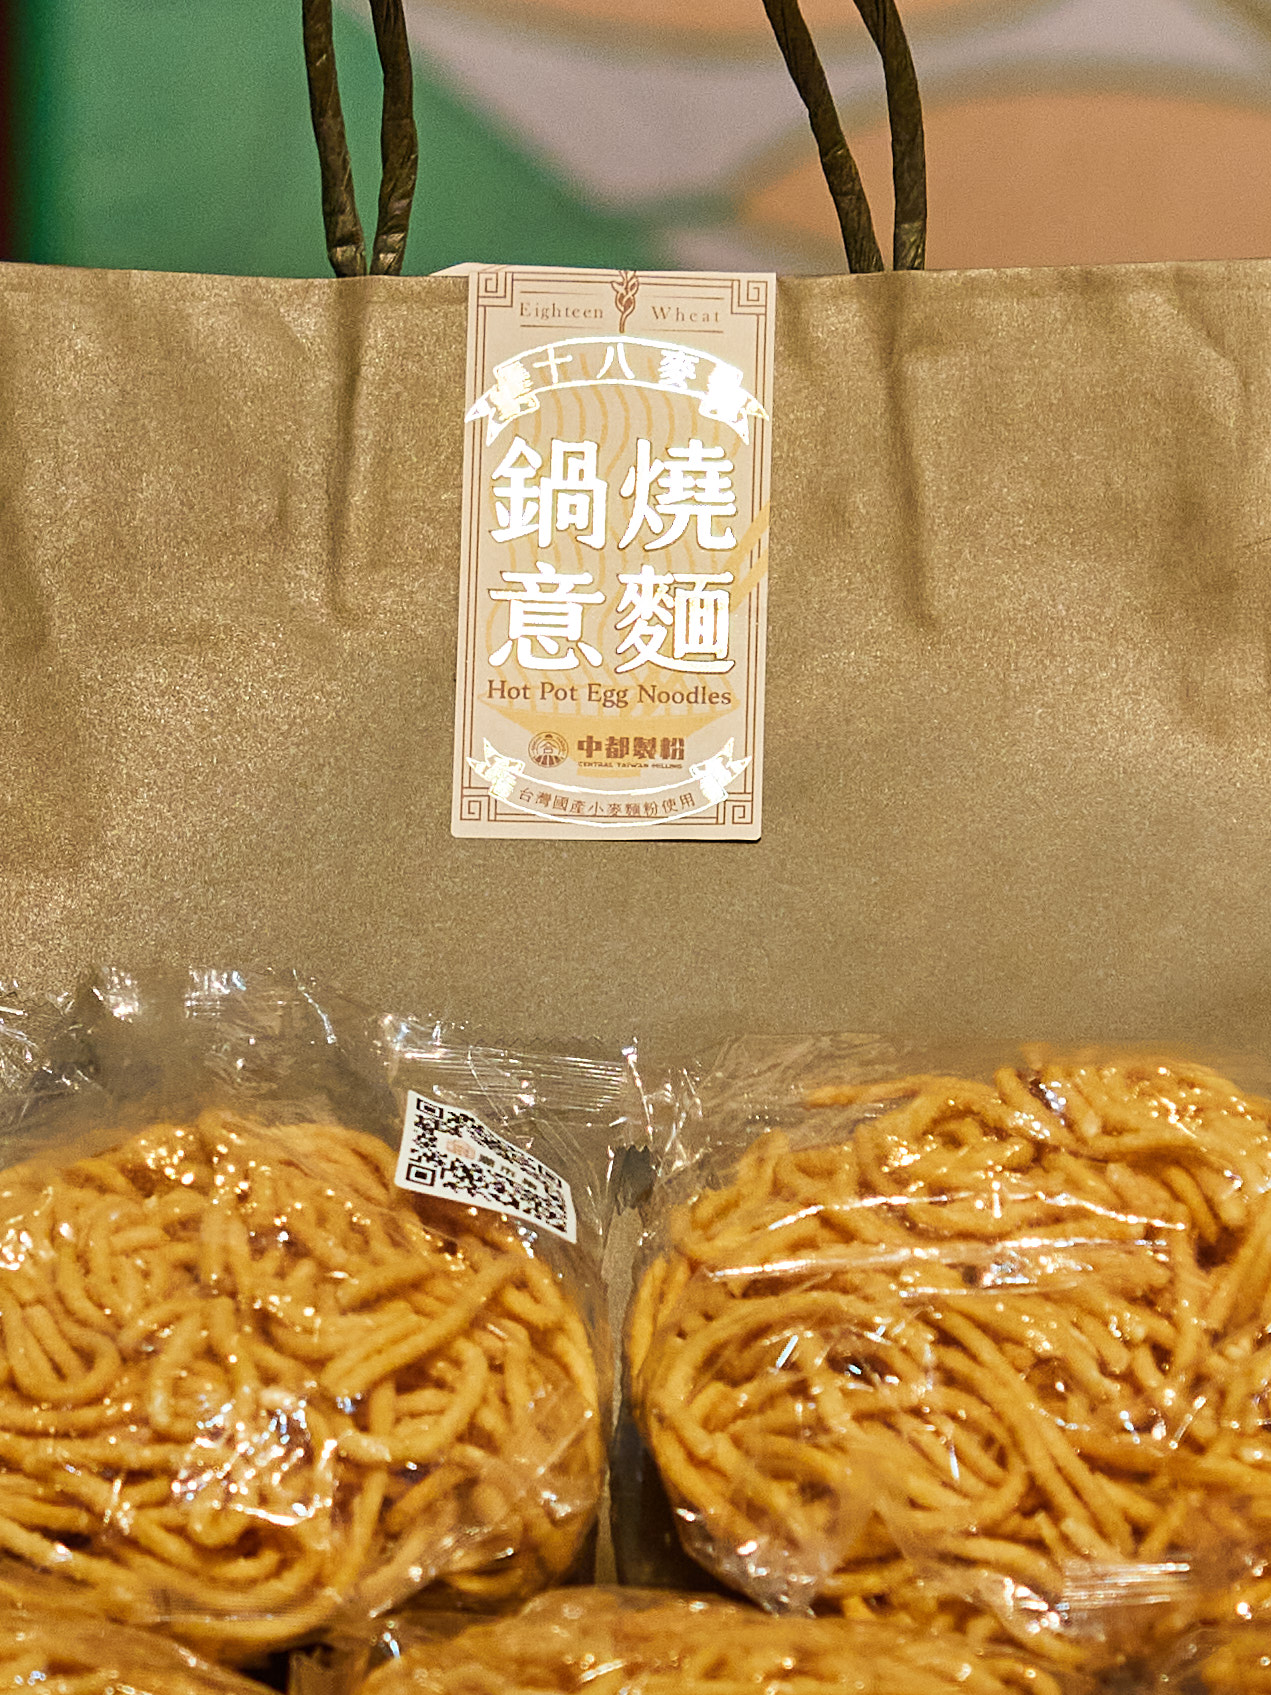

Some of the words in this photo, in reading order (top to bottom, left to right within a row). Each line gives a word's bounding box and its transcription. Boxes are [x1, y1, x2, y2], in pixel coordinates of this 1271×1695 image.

[520, 301, 604, 320] Eighteen
[650, 305, 721, 322] Wheat
[488, 435, 738, 552] 鍋燒
[487, 560, 736, 675] 意麵
[487, 679, 530, 700] Hot
[539, 681, 578, 701] Pot
[587, 683, 629, 708] Egg
[637, 684, 732, 704] Noodles
[577, 735, 685, 760] 中都製粉
